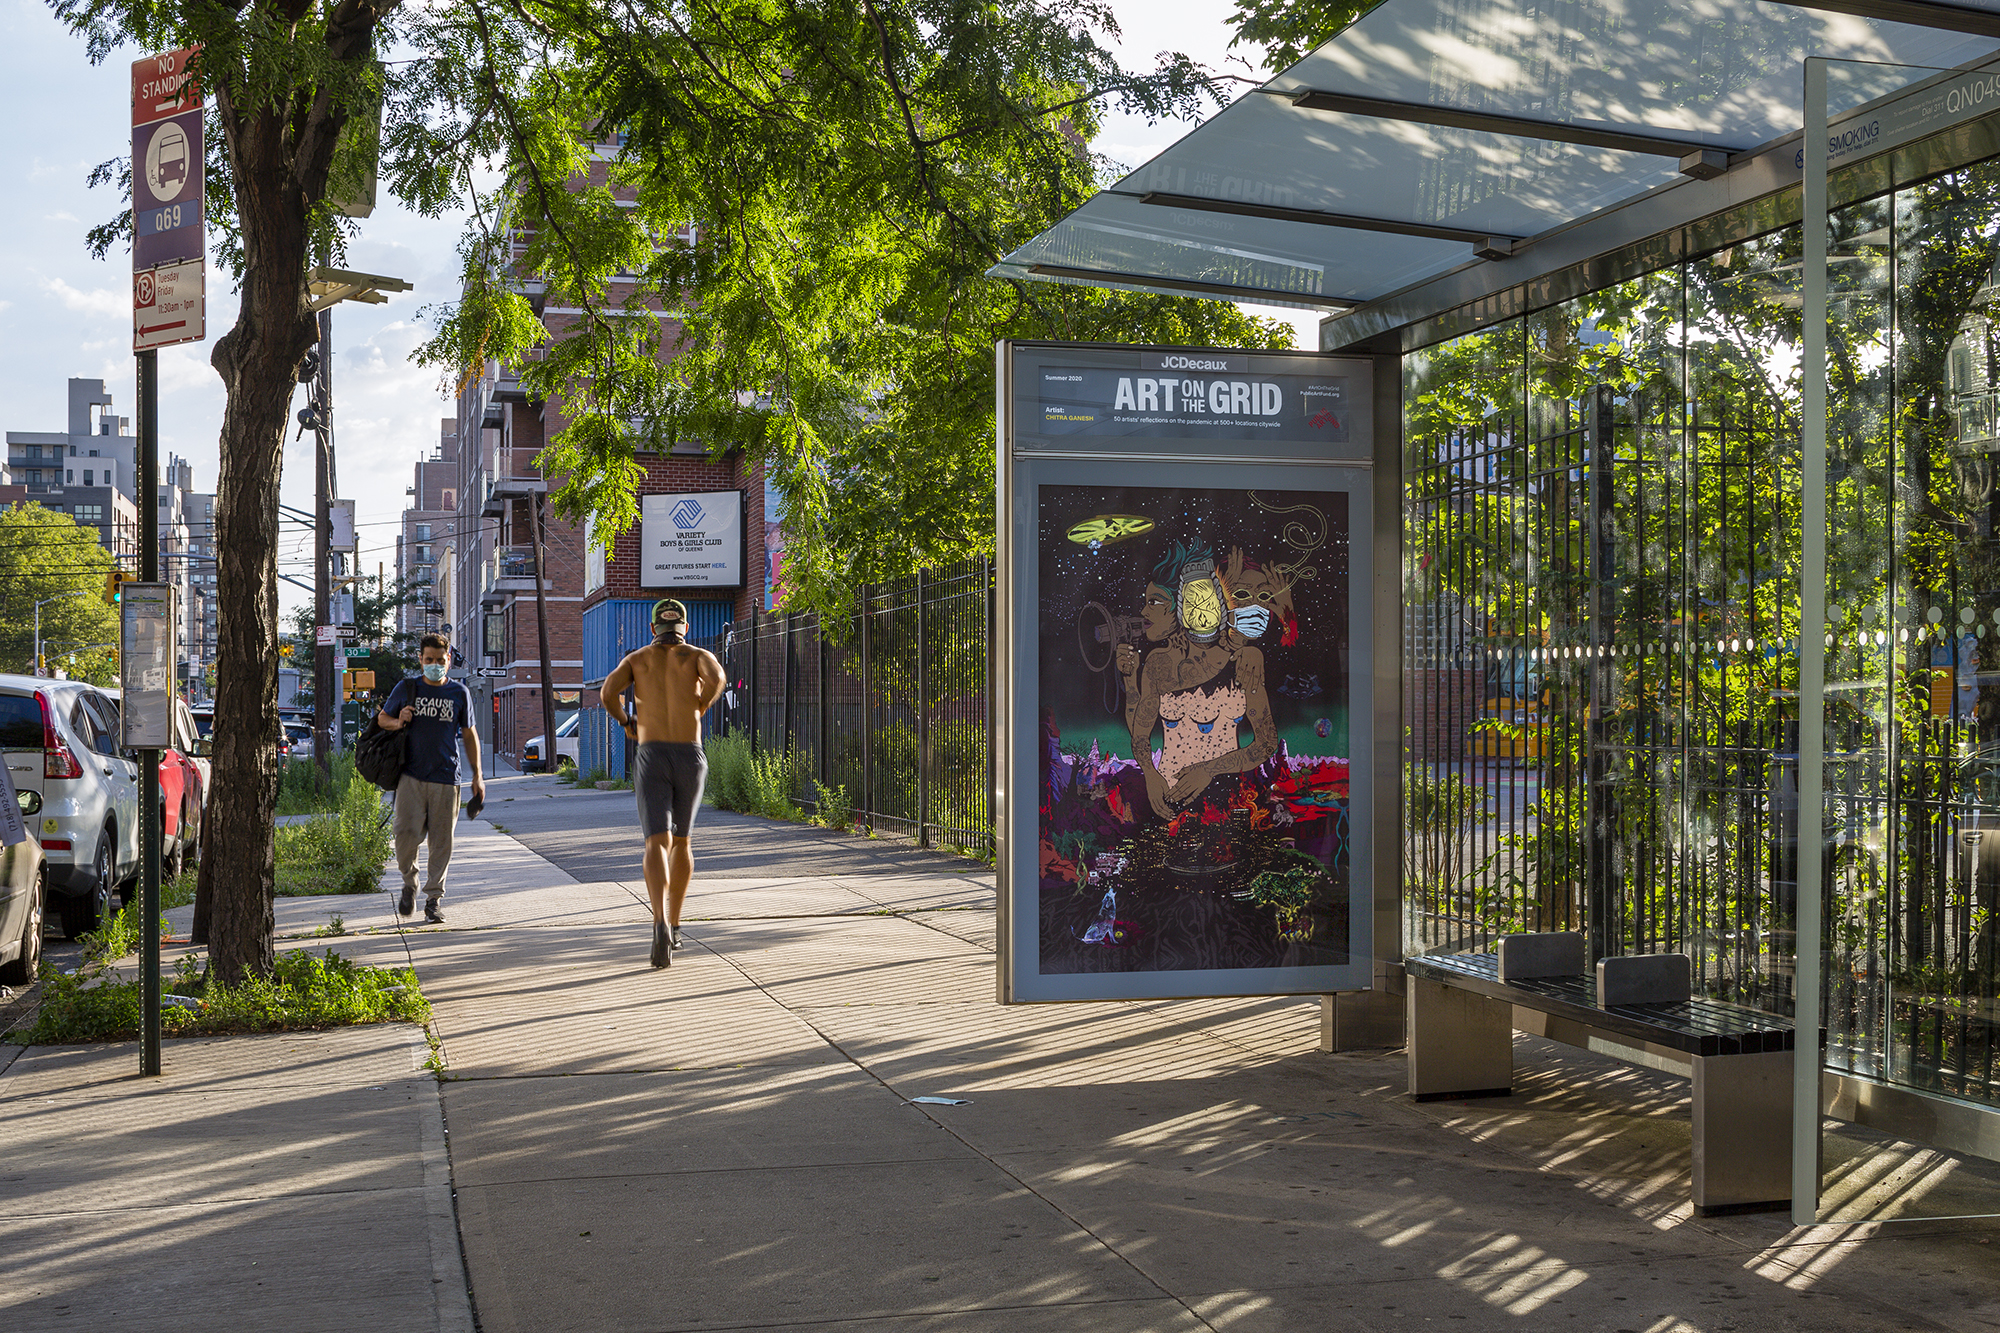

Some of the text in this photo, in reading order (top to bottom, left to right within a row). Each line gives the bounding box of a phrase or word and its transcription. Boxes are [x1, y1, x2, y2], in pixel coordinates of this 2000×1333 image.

[158, 56, 175, 75] NO
[1921, 105, 1933, 117] Dial
[1933, 101, 1944, 112] 311
[1828, 120, 1879, 153] SMOKING
[156, 204, 181, 231] Q69
[158, 271, 180, 284] Tuesday
[157, 285, 174, 297] Friday
[158, 302, 180, 315] 11:30am
[183, 299, 194, 311] 1pm
[1160, 355, 1228, 371] JCDecaux
[1114, 377, 1179, 412] ART
[1181, 379, 1205, 398] ON
[1299, 390, 1340, 398] PublicArtFund.org
[1181, 398, 1205, 413] THE
[1208, 380, 1283, 416] GRID
[1140, 416, 1168, 424] reflections
[1186, 418, 1212, 426] pandemic
[1258, 420, 1281, 428] citywide
[1308, 407, 1328, 428] PUBLIC
[1316, 416, 1328, 430] ART
[1325, 411, 1340, 429] FUND
[676, 531, 706, 539] VARIETY
[704, 538, 722, 546] CLUB
[347, 648, 359, 657] 30
[415, 697, 454, 710] ECAUSE
[414, 706, 454, 719] SAID SO
